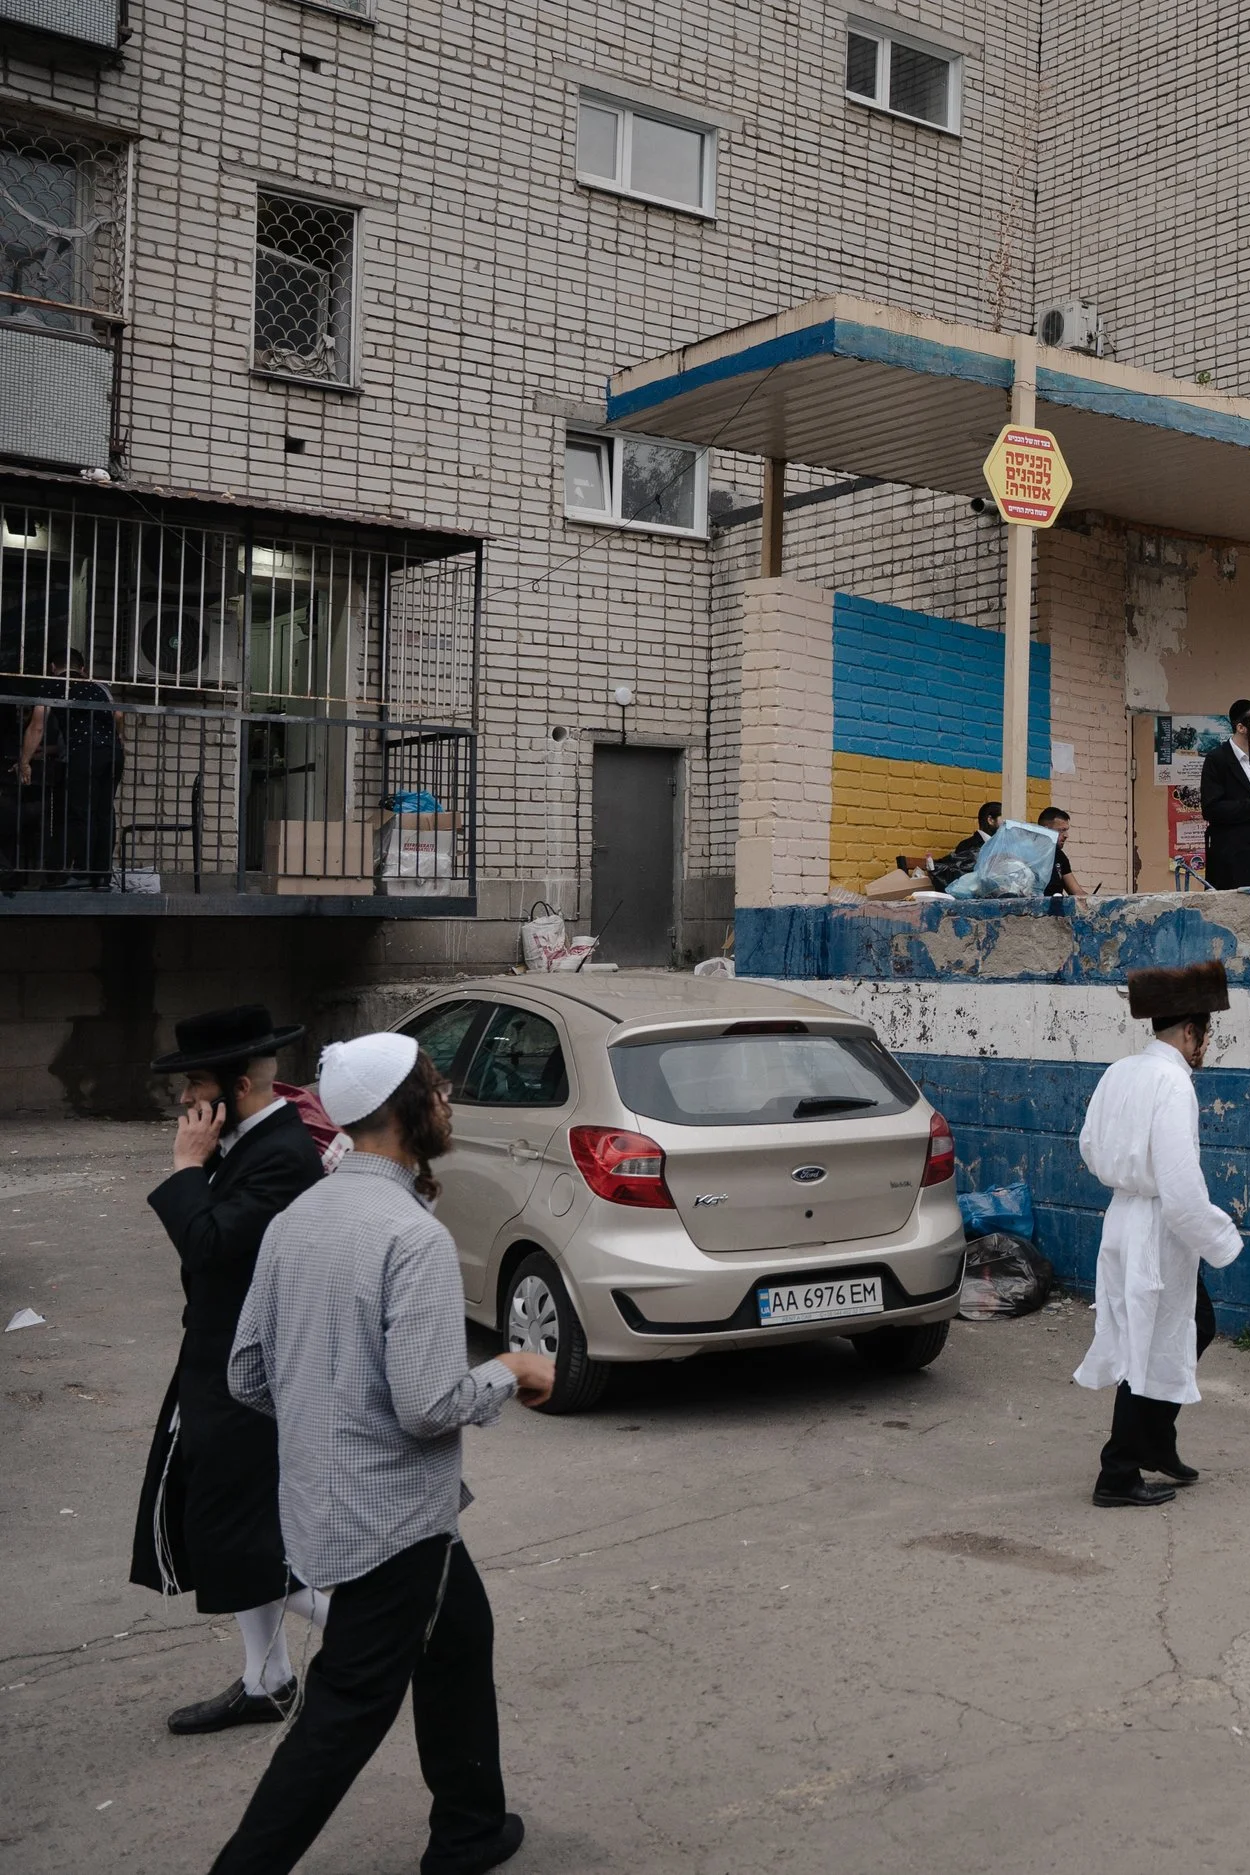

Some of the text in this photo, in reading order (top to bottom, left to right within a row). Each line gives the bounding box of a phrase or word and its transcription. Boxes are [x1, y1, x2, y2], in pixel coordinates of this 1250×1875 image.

[1006, 451, 1051, 471] הכניסה
[1006, 464, 1051, 485] לכהנים
[1005, 480, 1051, 501] אסורה!
[800, 1169, 820, 1178] Ford
[772, 1290, 799, 1313] AA
[804, 1285, 846, 1309] 6976
[850, 1282, 877, 1304] EM
